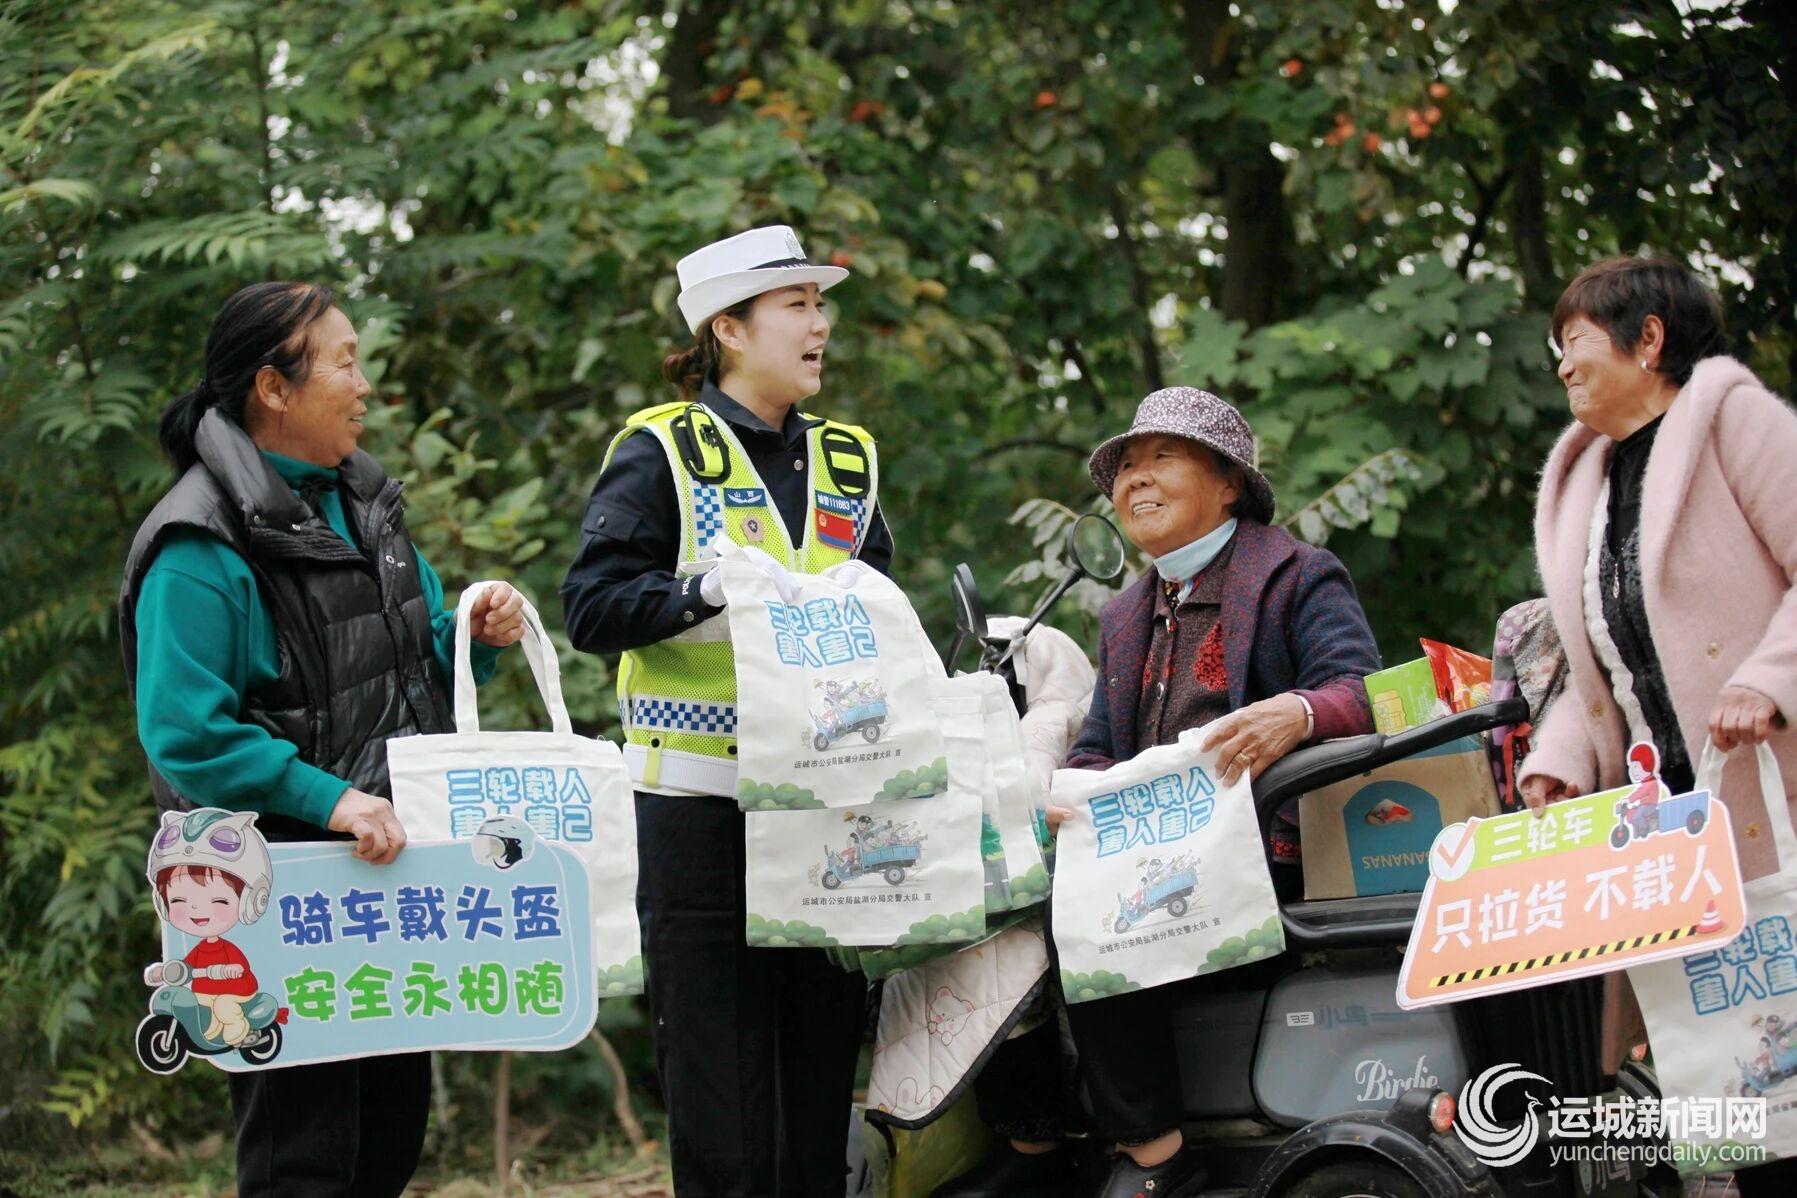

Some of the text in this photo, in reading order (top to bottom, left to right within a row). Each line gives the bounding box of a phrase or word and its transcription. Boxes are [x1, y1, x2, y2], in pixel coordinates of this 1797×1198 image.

[763, 594, 871, 636] 三轮载人
[775, 626, 878, 668] 害人害己
[447, 767, 592, 804] 三轮载人
[1088, 766, 1216, 828] 三轮载人
[451, 805, 593, 842] 害害己
[1096, 797, 1215, 858] 害人害己
[1490, 806, 1593, 863] 三轮车
[278, 885, 562, 946] 骑车戴头盔
[1431, 844, 1723, 954] 只拉货 不载人
[1682, 915, 1797, 977] 三轮载
[284, 960, 564, 1022] 安全永相随
[1355, 1055, 1438, 1102] Birdie
